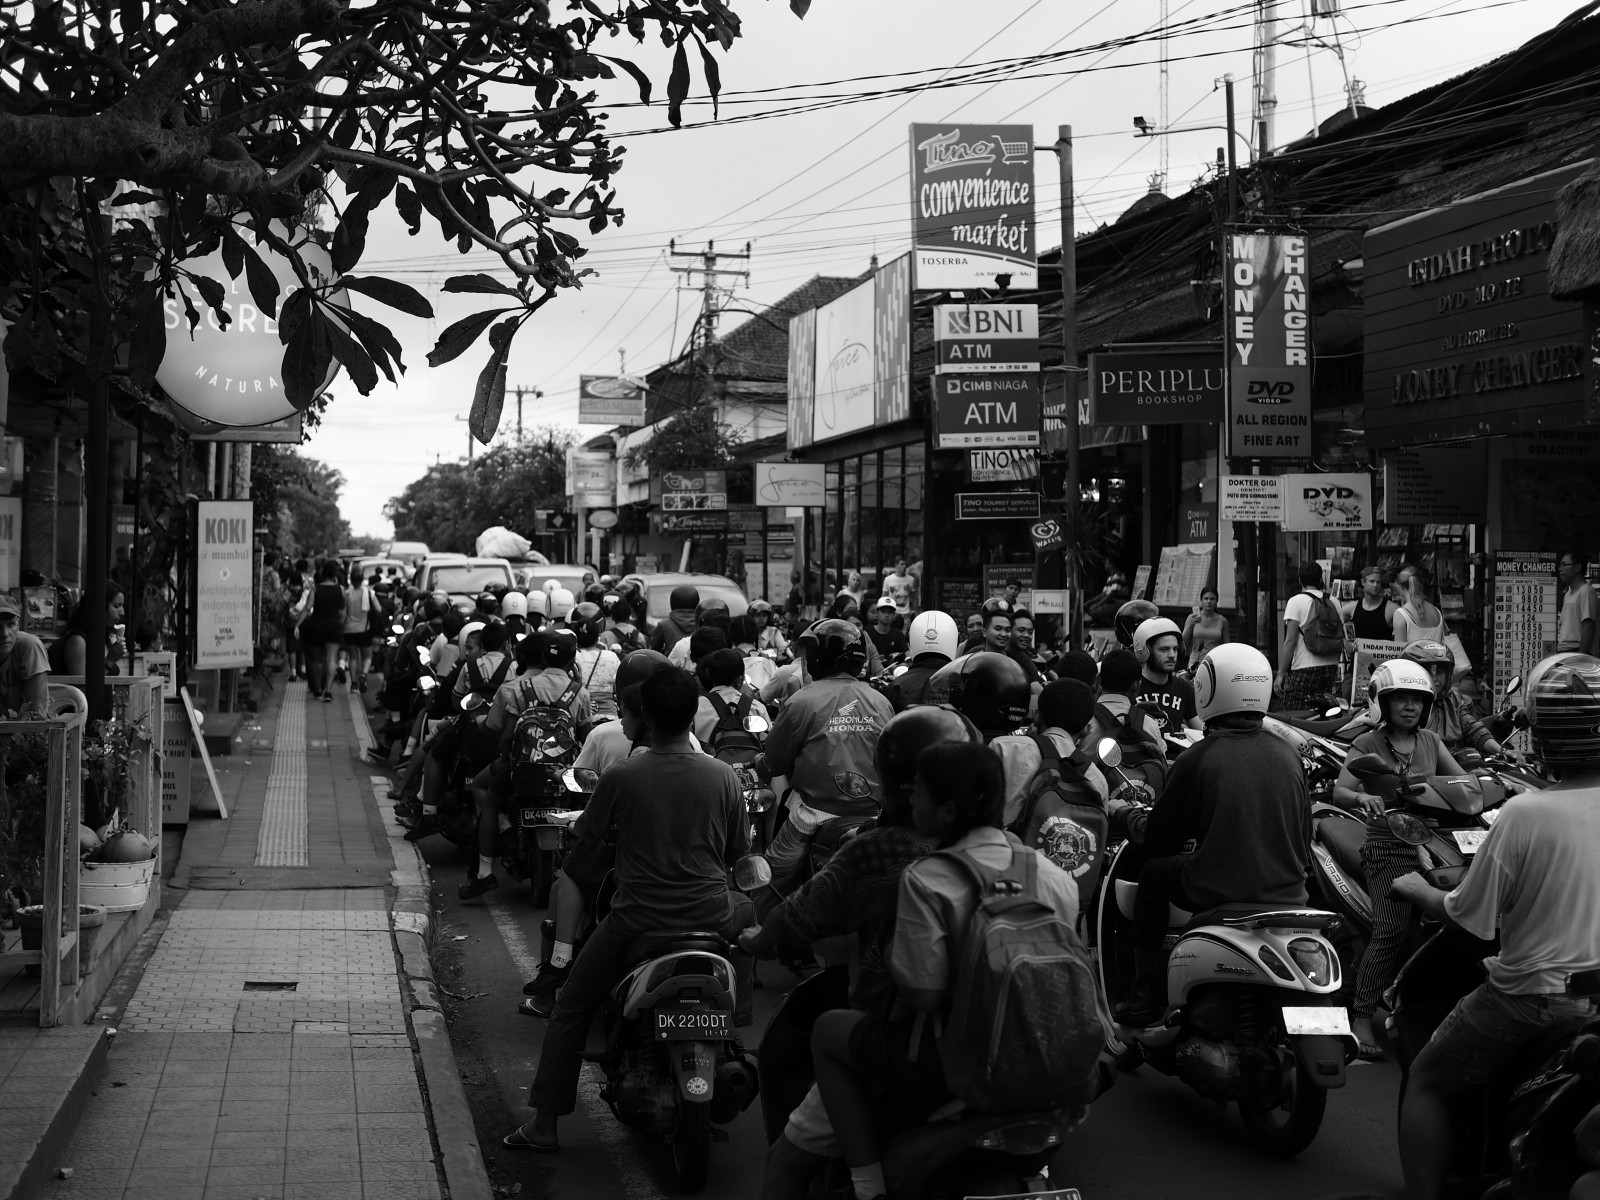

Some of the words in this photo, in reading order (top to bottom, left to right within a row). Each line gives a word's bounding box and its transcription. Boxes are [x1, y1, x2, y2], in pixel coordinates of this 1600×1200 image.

[918, 128, 996, 170] Tino
[921, 168, 1030, 218] convenience
[951, 214, 1028, 254] market
[921, 257, 969, 266] TOSERBA
[1233, 236, 1254, 365] MONEY
[1284, 238, 1307, 366] CHANGER
[975, 309, 1023, 333] BNI
[949, 344, 992, 359] ATM
[962, 381, 993, 392] CIMB
[993, 380, 1029, 391] NIAGA
[1248, 380, 1295, 396] DVD
[1137, 394, 1203, 405] BOOKSHOP
[964, 401, 1018, 425] ATM
[1236, 414, 1259, 426] ALL
[1262, 414, 1307, 426] REGION
[1243, 435, 1273, 446] FINE
[1276, 435, 1301, 446] ART
[971, 451, 1009, 469] TINO
[1228, 479, 1259, 487] DOKTER
[1260, 479, 1277, 487] GIGI
[1303, 487, 1354, 500] DVD
[205, 518, 247, 544] KOKI
[1189, 520, 1208, 539] ATM
[211, 550, 250, 560] mumbul
[1496, 561, 1521, 572] MONEY
[1522, 561, 1556, 572] CHANGER
[1516, 585, 1543, 595] 13050
[201, 600, 251, 611] Indonesian
[1515, 603, 1543, 613] 14450
[213, 613, 240, 625] Touch
[1521, 613, 1536, 623] 124
[1515, 621, 1543, 632] 16850
[1514, 631, 1543, 641] 13050
[1362, 643, 1384, 651] INDAH
[1520, 641, 1542, 651] 9700
[1519, 650, 1542, 660] 9500
[828, 724, 876, 732] HONDA
[1325, 855, 1350, 894] VARIO
[658, 1014, 676, 1028] DK
